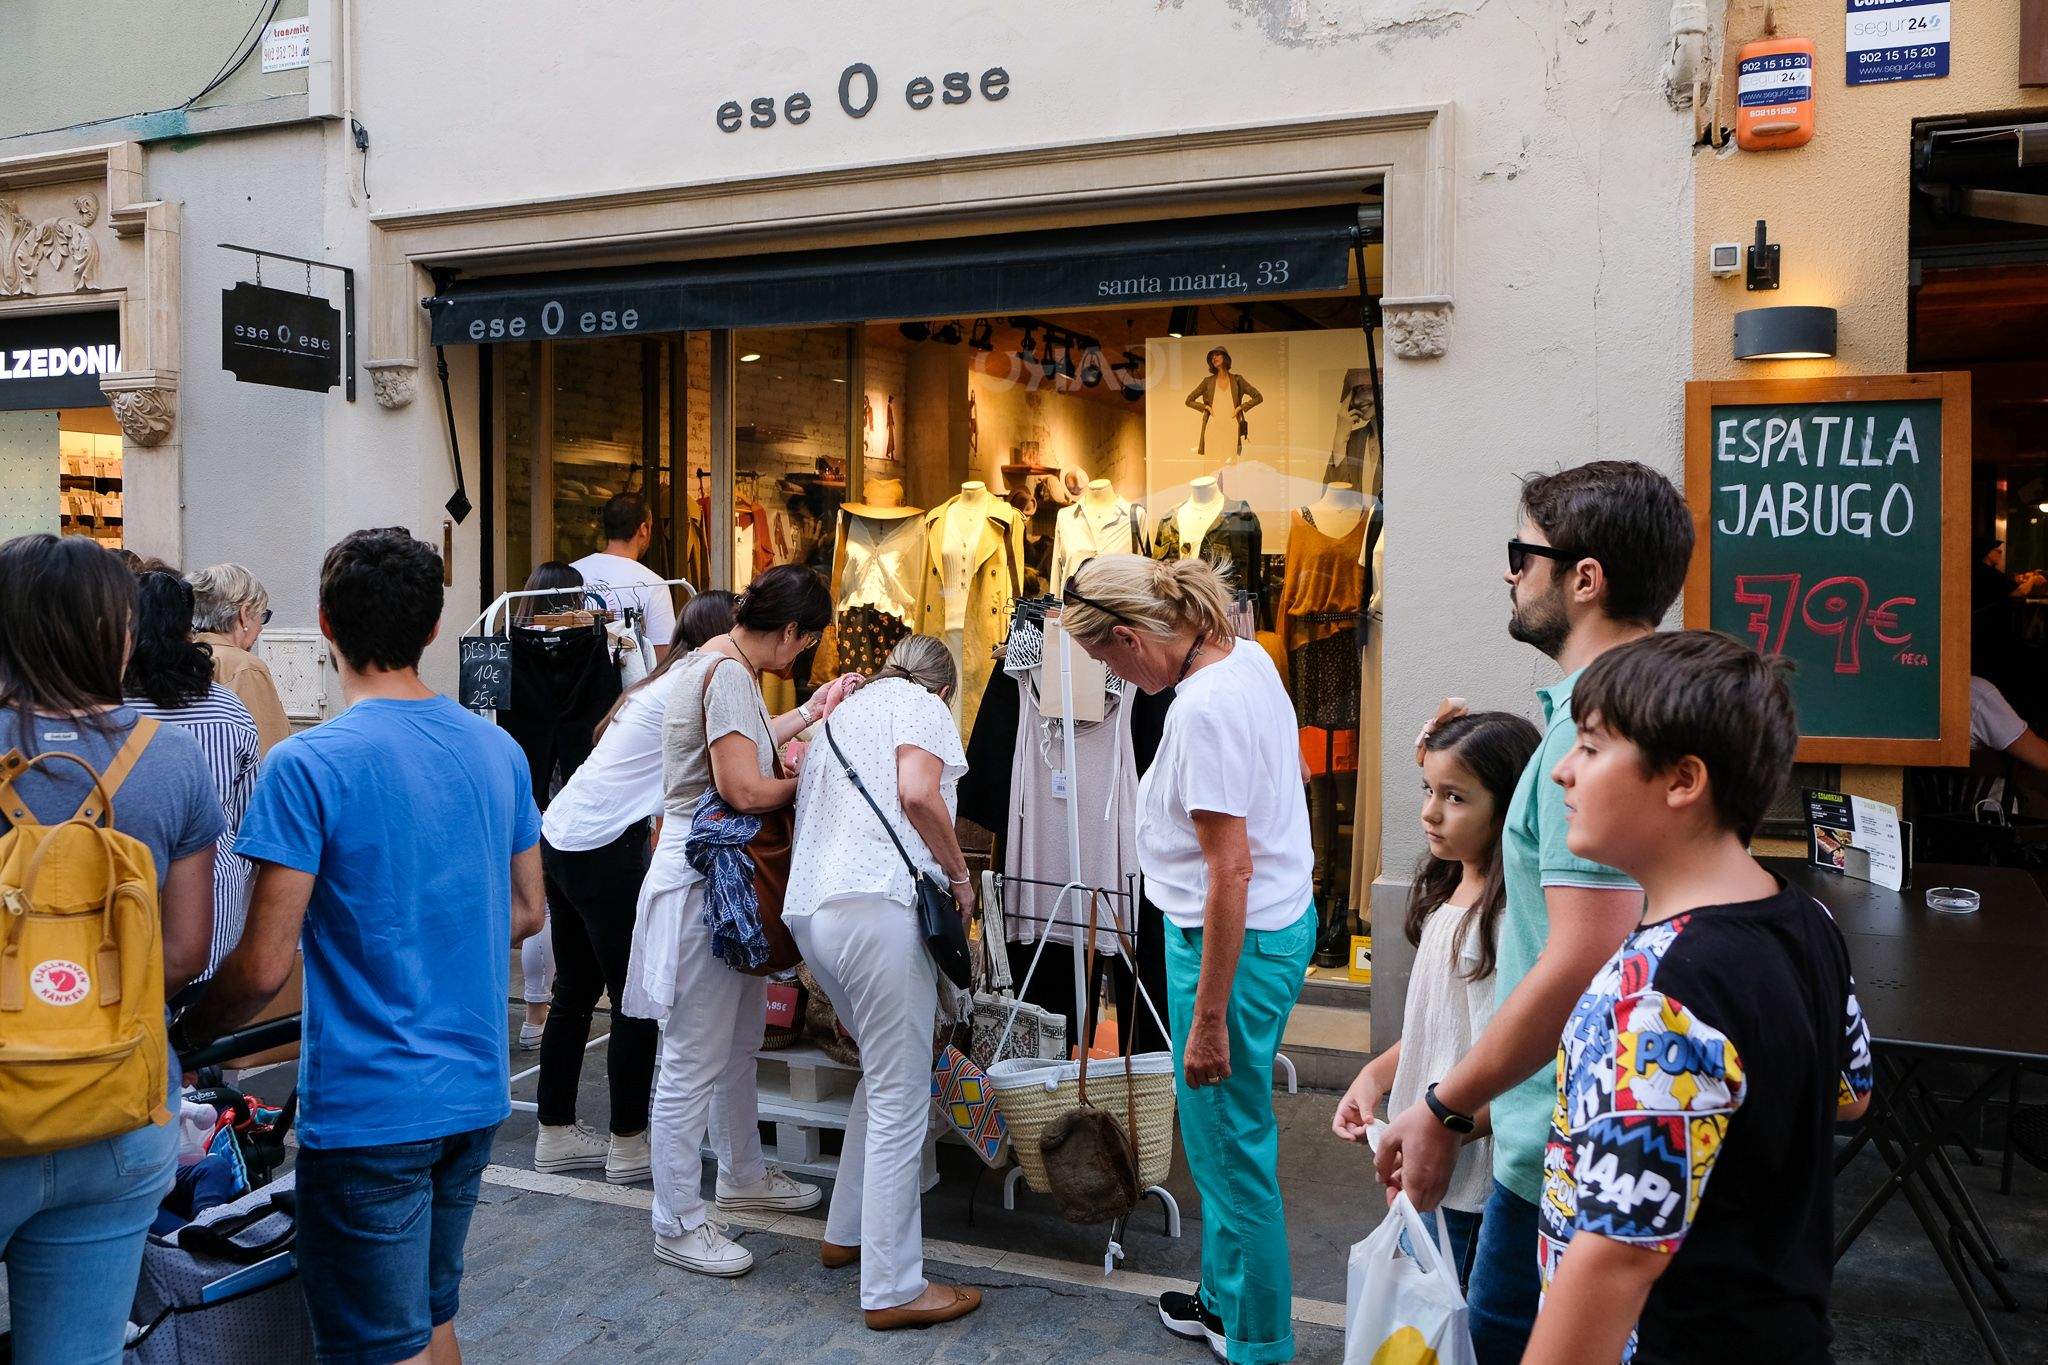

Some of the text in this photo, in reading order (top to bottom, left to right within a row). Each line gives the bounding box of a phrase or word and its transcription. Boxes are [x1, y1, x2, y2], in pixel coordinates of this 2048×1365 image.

[1742, 57, 1807, 72] 902 15 15 20
[1859, 47, 1936, 63] 902 15 15 20
[1859, 61, 1936, 75] www.segur24.es
[716, 92, 811, 133] ese
[905, 66, 1010, 111] ese
[1098, 260, 1289, 296] santa maria, 33
[234, 324, 269, 340] ese
[300, 335, 331, 350] ese
[469, 317, 526, 340] ese
[580, 308, 639, 333] ese
[1718, 416, 1920, 468] ESPATLLA
[1718, 481, 1914, 538] JABUGO
[1735, 573, 1916, 674] 79€
[474, 664, 501, 684] 10€
[470, 690, 497, 708] 25€
